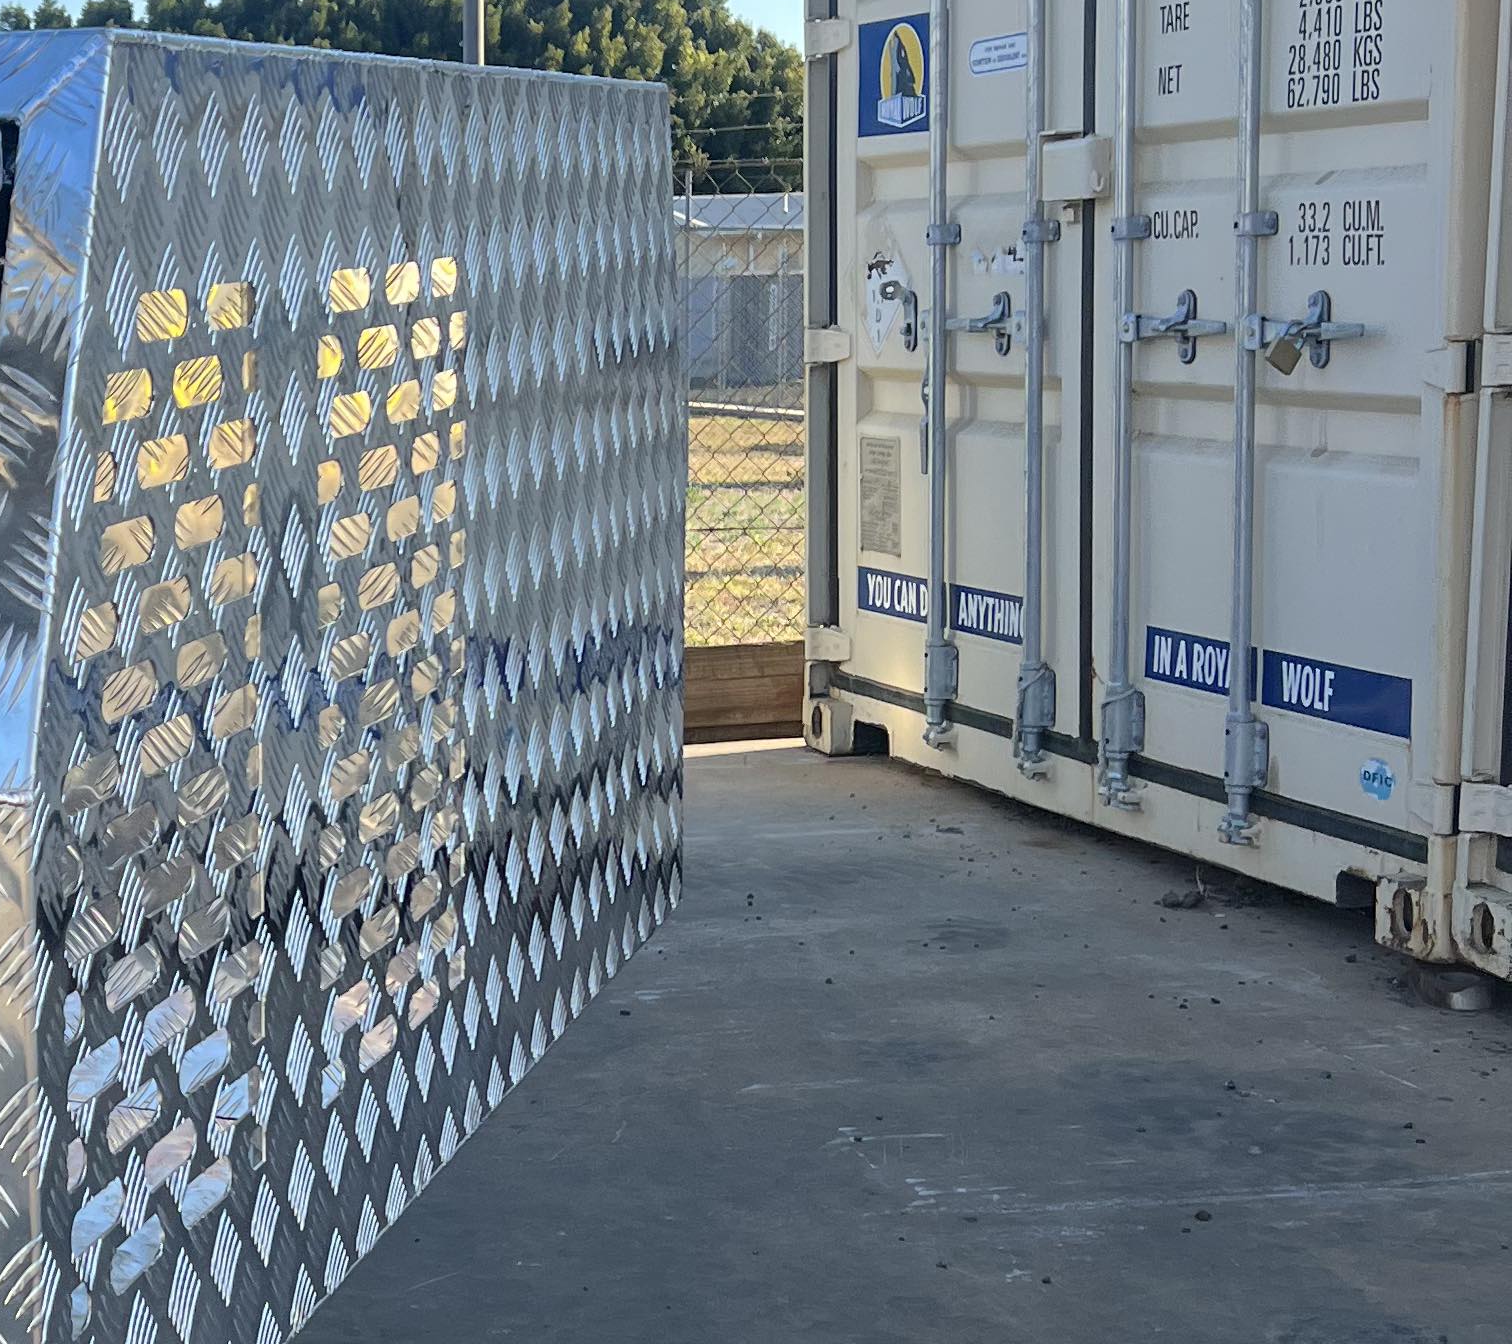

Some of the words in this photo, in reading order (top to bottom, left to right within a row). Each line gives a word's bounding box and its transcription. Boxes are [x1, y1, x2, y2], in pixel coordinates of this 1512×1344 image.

[1159, 1, 1190, 35] TARE
[1298, 5, 1342, 41] 4,410
[1158, 64, 1183, 97] NET
[1288, 39, 1341, 75] 28,480
[1353, 33, 1383, 69] KGS
[1287, 73, 1341, 109] 62,790
[1352, 68, 1380, 102] LBS
[1153, 210, 1199, 240] CU.CAP.
[1298, 202, 1330, 233] 33.2
[1343, 199, 1385, 232] CU.M.
[1288, 234, 1331, 266] 1,173
[1342, 233, 1385, 266] CU.FT.
[866, 573, 891, 610] YOU
[894, 579, 917, 616] CAN
[1153, 634, 1173, 676] IN
[1174, 639, 1188, 680] A
[1281, 660, 1336, 712] WOLF
